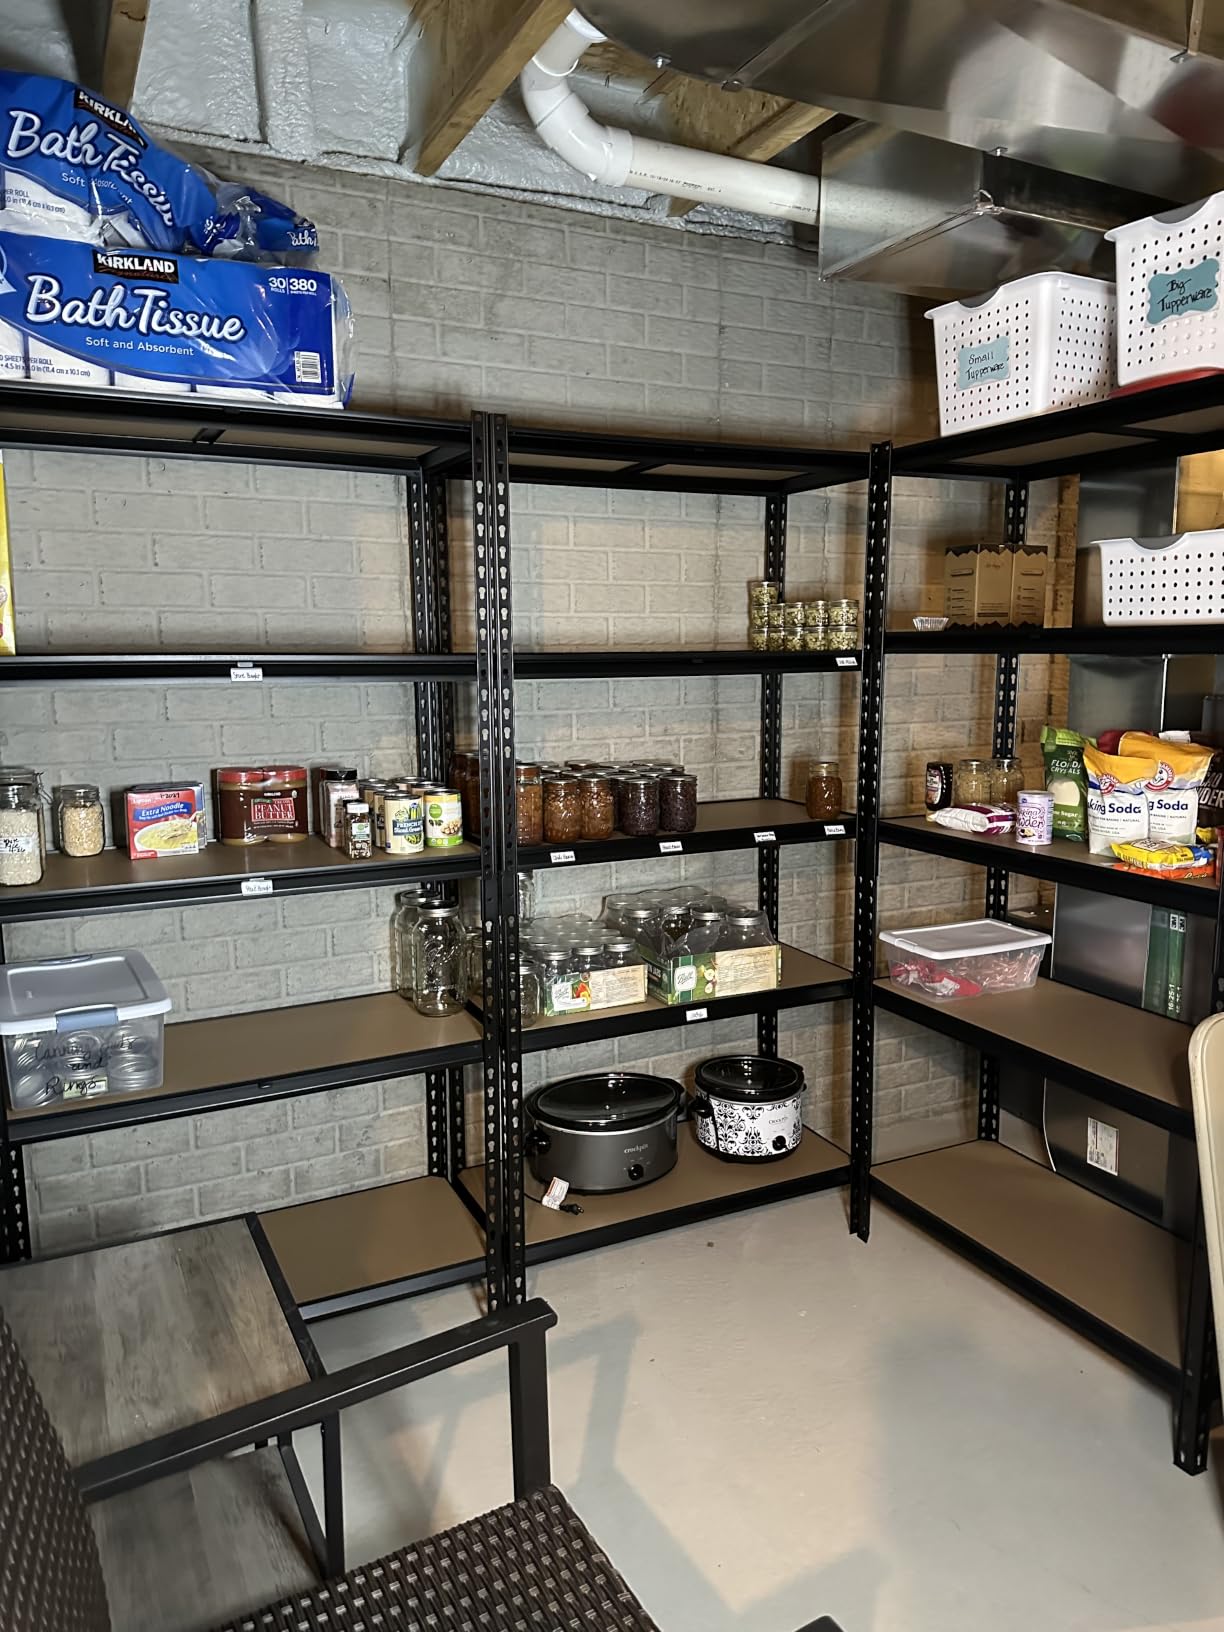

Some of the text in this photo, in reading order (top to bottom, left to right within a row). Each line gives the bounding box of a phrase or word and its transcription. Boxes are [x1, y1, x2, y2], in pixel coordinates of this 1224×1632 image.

[7, 110, 103, 167] Bath
[62, 172, 86, 187] Soft
[97, 254, 174, 273] KIRKLAND
[268, 276, 317, 292] 30 380
[1166, 278, 1192, 295] Big
[26, 275, 136, 329] Bath
[1157, 287, 1212, 313] Tupperware
[133, 288, 245, 341] Tissue
[85, 336, 194, 357] Soft and Absorbent
[968, 351, 994, 365] Small
[965, 362, 1004, 381] Tupperware
[1050, 766, 1081, 775] CRYSALS
[141, 802, 184, 817] Extra Noodle
[254, 804, 293, 813] PEANUT
[1108, 803, 1141, 814] Soda
[1157, 799, 1188, 811] Soda
[254, 811, 294, 820] BUTTER
[45, 1075, 106, 1096] Rings
